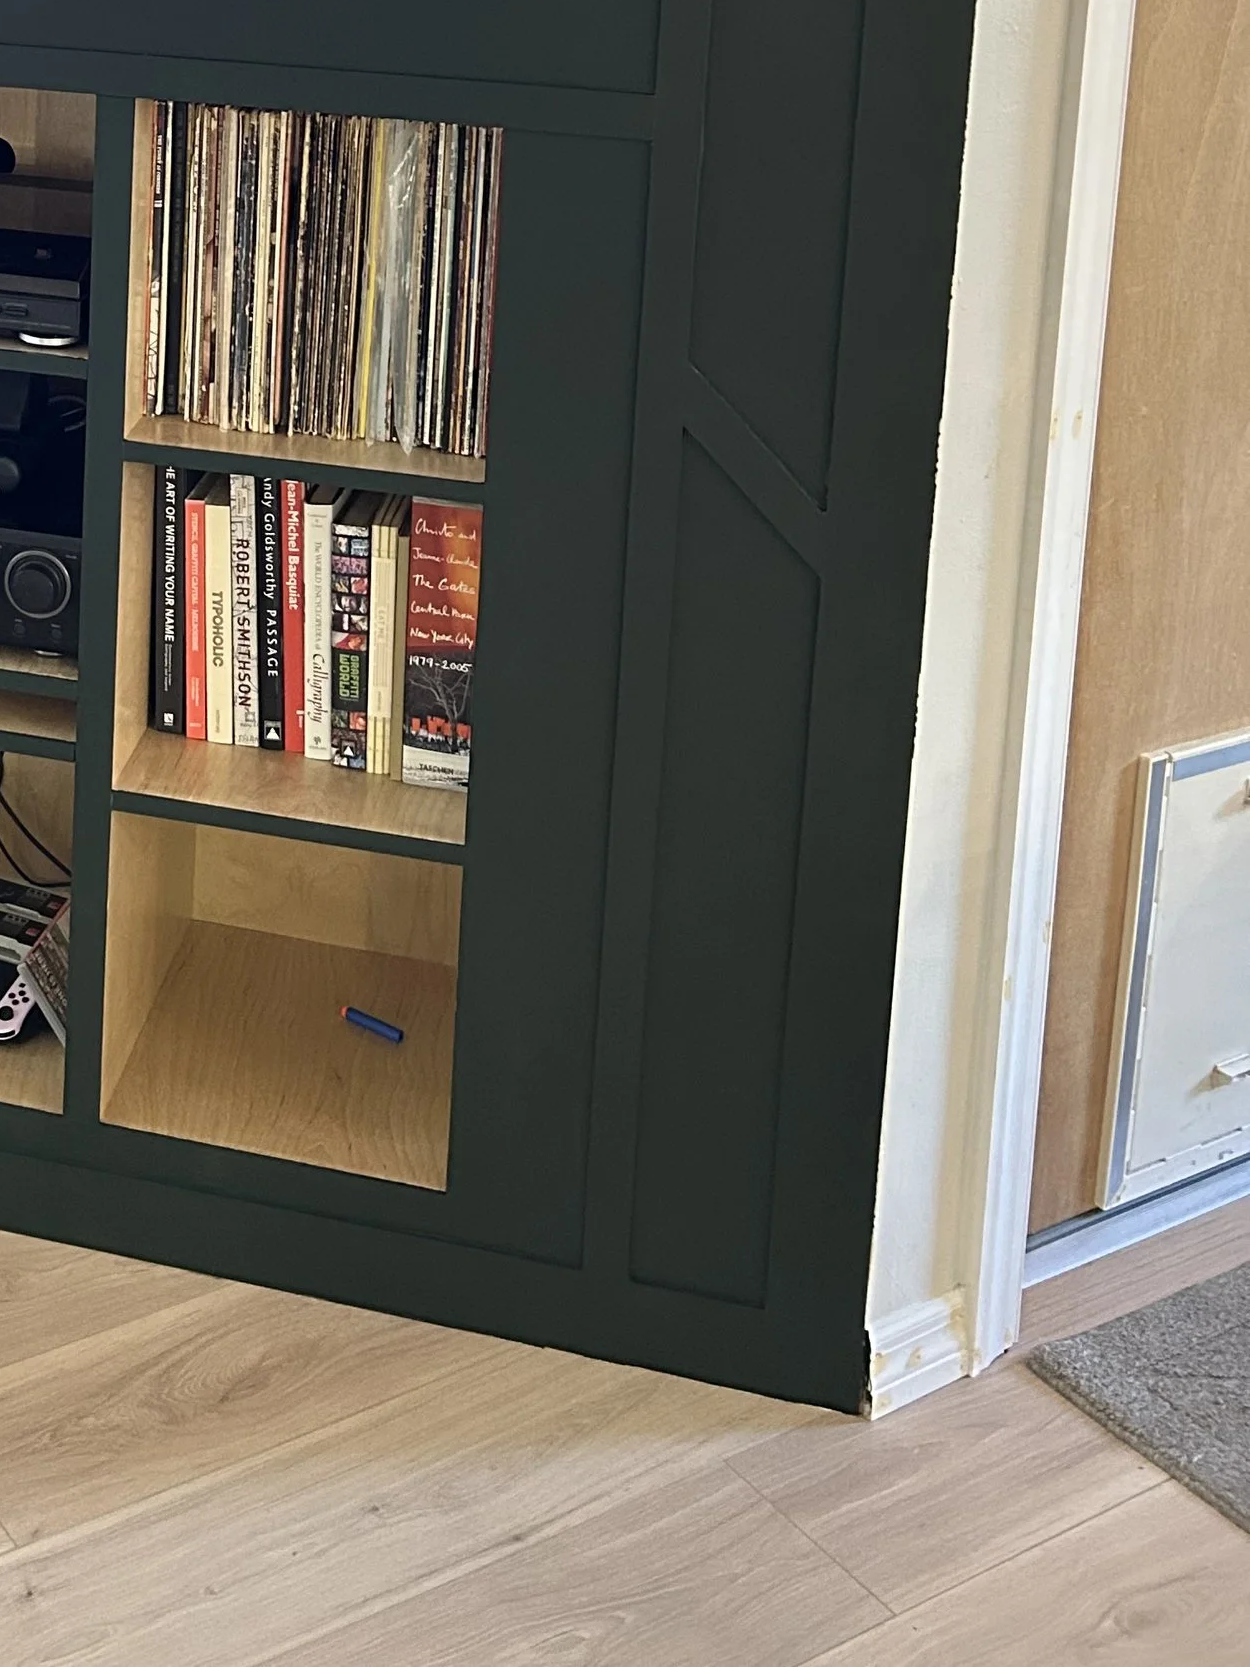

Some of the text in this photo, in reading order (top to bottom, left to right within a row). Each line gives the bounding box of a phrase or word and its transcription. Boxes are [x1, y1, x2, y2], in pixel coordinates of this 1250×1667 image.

[165, 481, 176, 505] ART
[165, 507, 176, 522] OF
[415, 518, 477, 541] Christo and
[165, 524, 176, 573] WRITING
[263, 513, 277, 599] Goldsworthy
[286, 479, 300, 610] Jean-Michel Basquiat
[236, 539, 250, 609] ROBERT
[314, 553, 322, 584] WORLD
[412, 573, 476, 595] The Gates
[164, 575, 175, 606] YOUR
[410, 600, 450, 617] Central
[164, 608, 175, 642] NAME
[212, 591, 224, 667] TYPOHOLIC
[314, 584, 323, 642] ENCYCLOPEDIA
[266, 609, 278, 677] PASSAGE
[410, 626, 475, 650] New York City
[237, 616, 252, 707] SMITHSON
[339, 653, 350, 697] WORLD
[350, 655, 360, 699] GRAFFITI
[409, 654, 473, 674] 1979-2005
[307, 653, 329, 724] Calligraphy
[418, 762, 454, 776] TASCHEN
